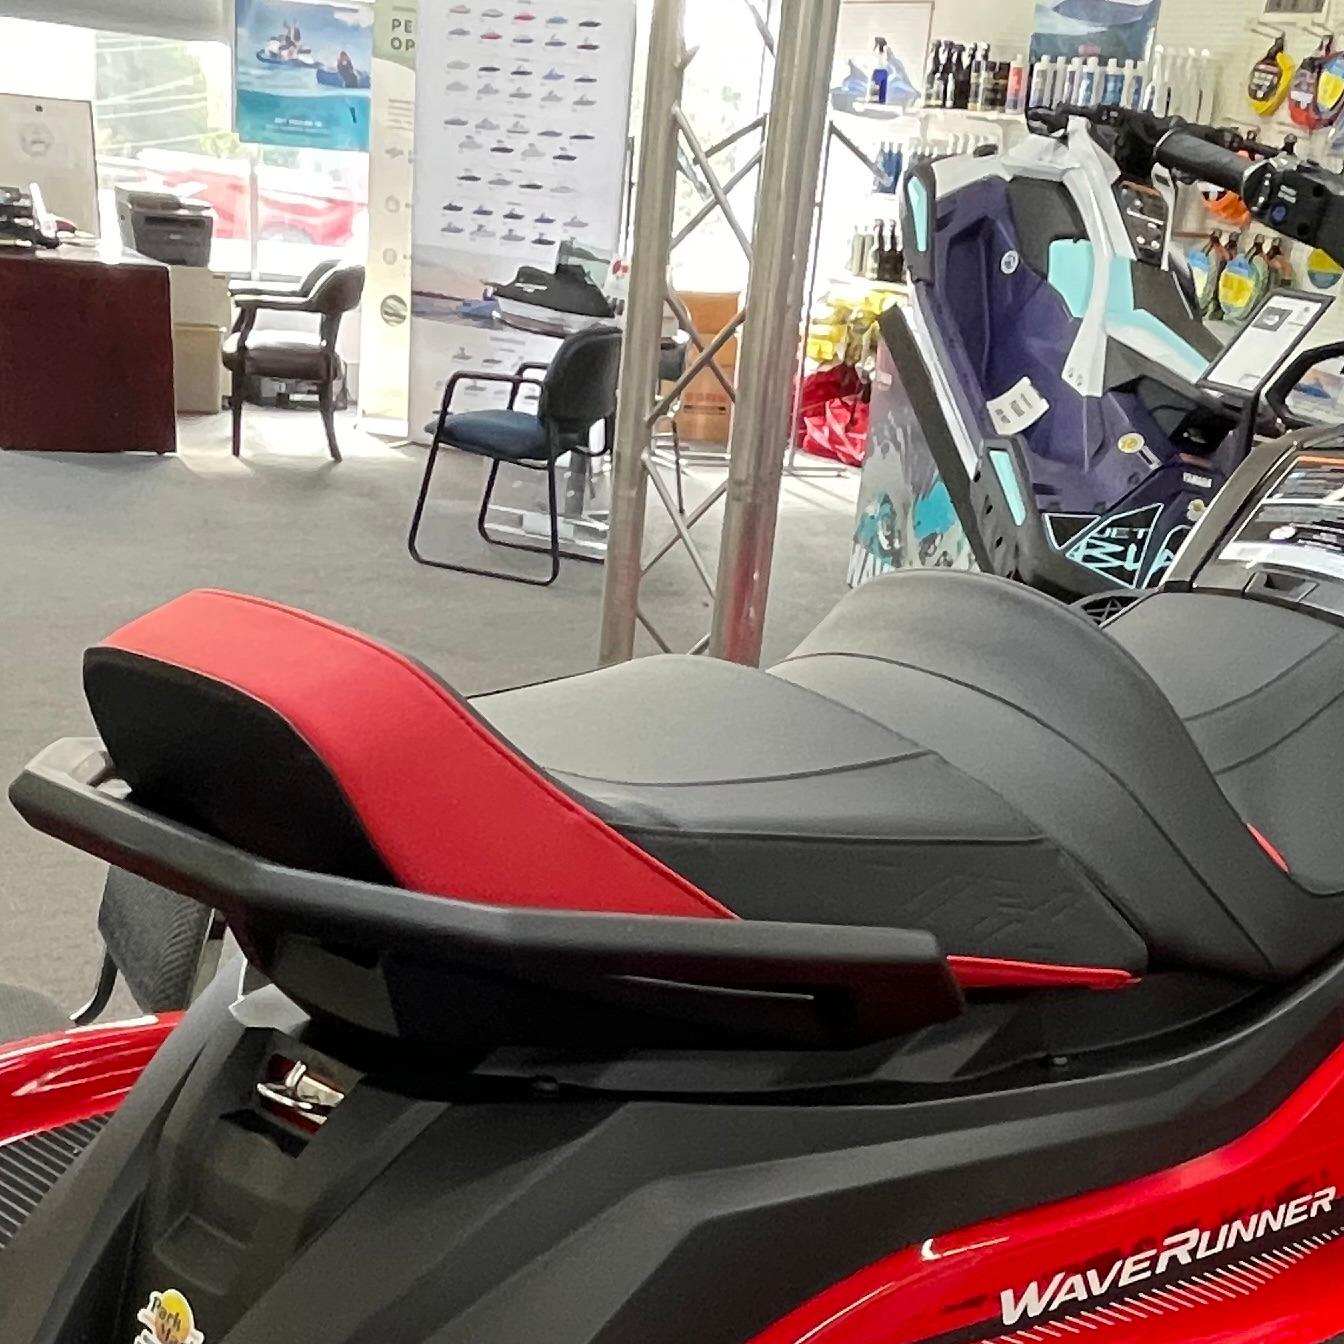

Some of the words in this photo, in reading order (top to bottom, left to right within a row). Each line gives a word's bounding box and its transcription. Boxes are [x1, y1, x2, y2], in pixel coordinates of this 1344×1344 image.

[392, 18, 413, 34] PE
[390, 36, 416, 52] OP
[999, 1186, 1337, 1327] WAVERUNNER
